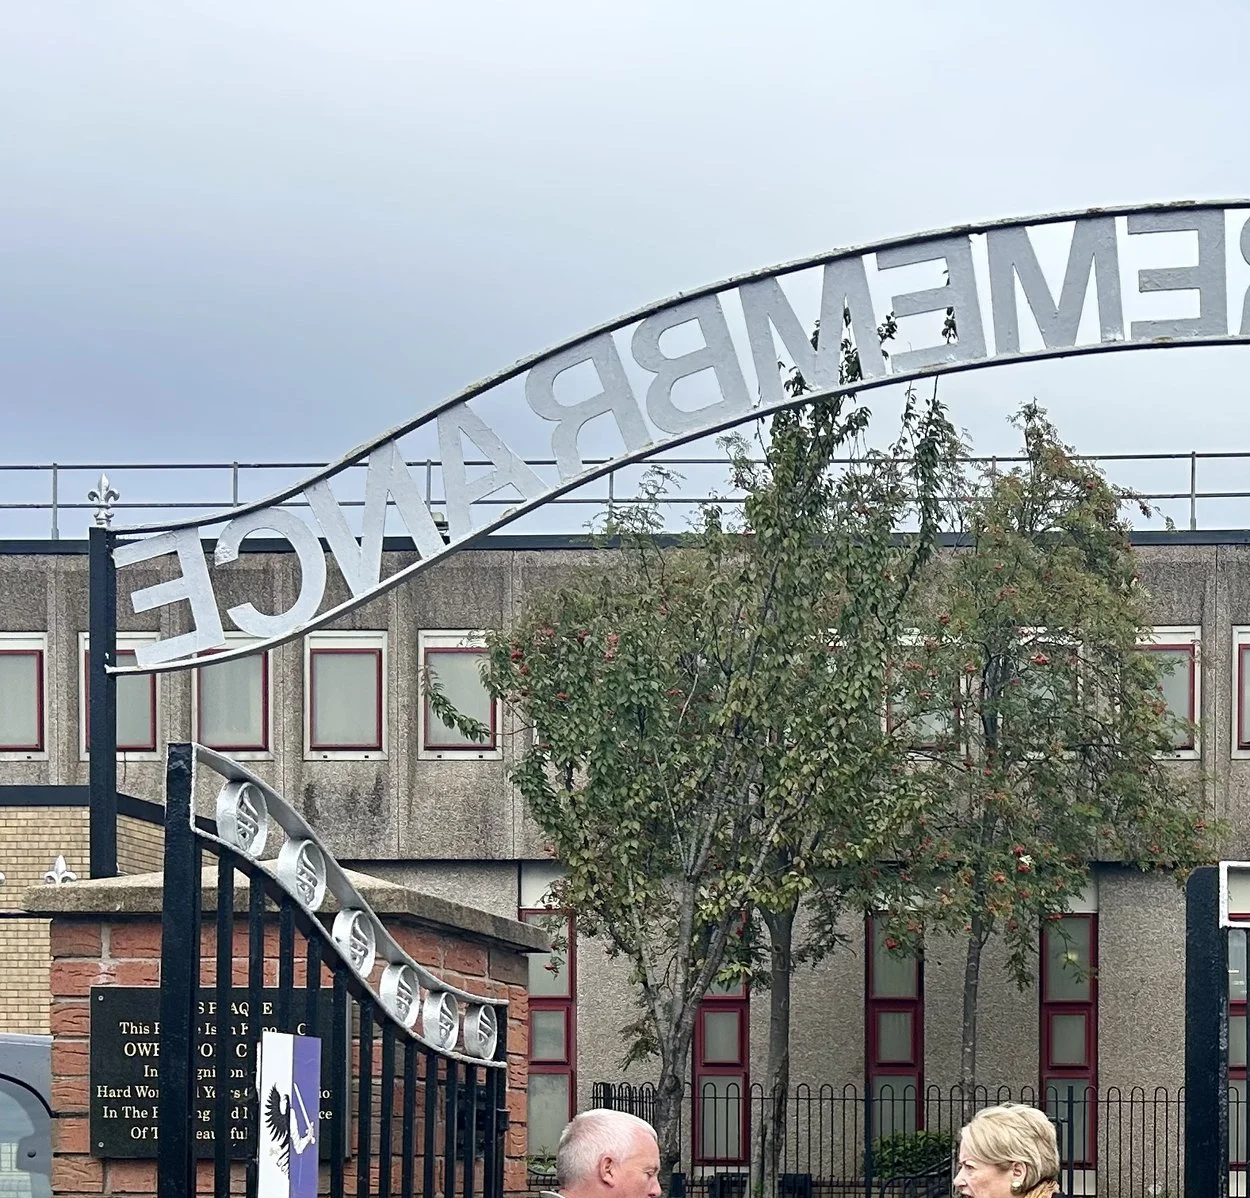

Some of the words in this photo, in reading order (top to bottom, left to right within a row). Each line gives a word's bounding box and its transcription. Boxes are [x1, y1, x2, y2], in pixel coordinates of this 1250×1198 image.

[208, 1001, 273, 1017] PAQE
[119, 1021, 151, 1035] This
[143, 1064, 159, 1077] In
[96, 1085, 132, 1098] Hard
[103, 1106, 118, 1119] In
[122, 1105, 149, 1119] The
[130, 1126, 149, 1139] Of
